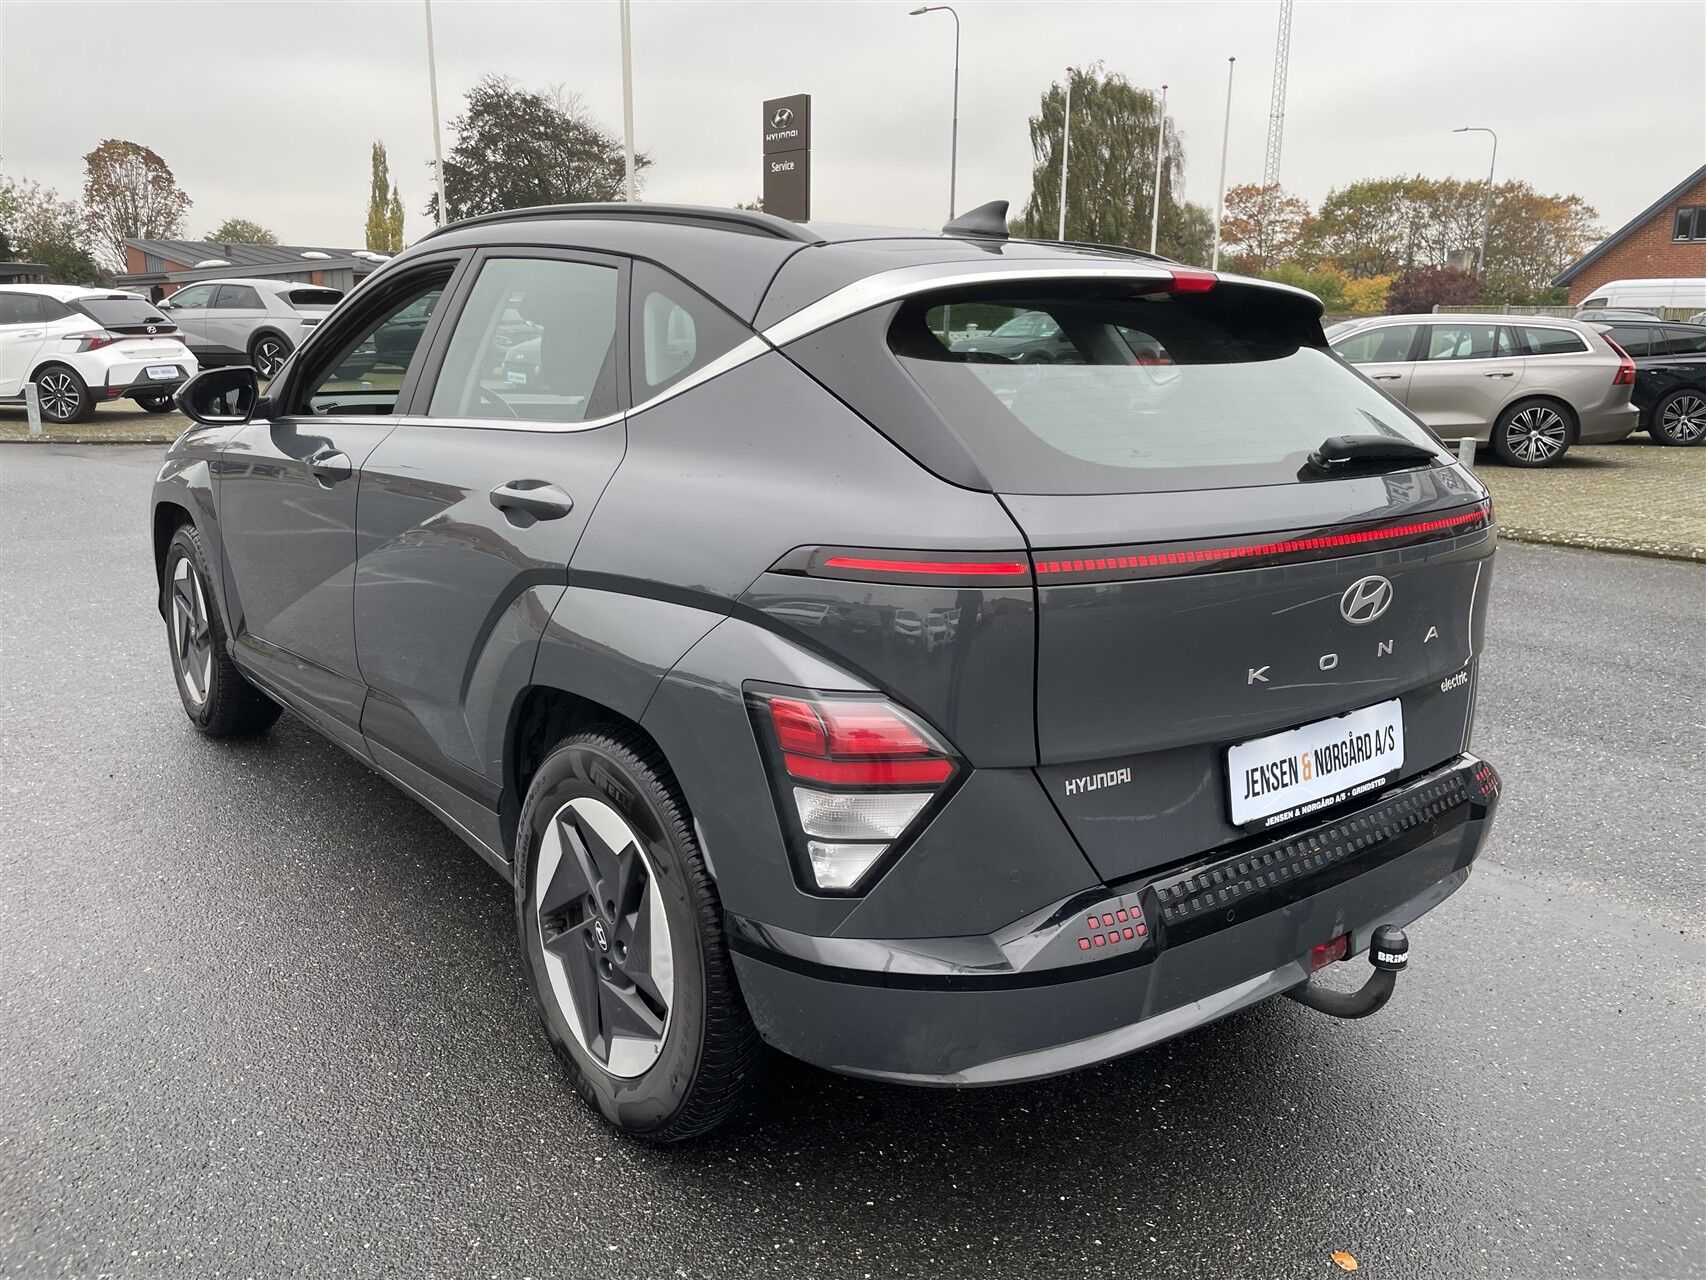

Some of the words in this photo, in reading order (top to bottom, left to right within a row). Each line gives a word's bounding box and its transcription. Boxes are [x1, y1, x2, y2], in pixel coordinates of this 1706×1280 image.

[766, 129, 799, 141] HYUNDAI
[771, 160, 795, 173] Service
[1247, 626, 1439, 685] KONA
[1440, 671, 1468, 693] electric
[1244, 755, 1299, 800] JENSEN
[1301, 752, 1312, 782] &
[1314, 731, 1372, 778] NØRGÅRD
[1375, 724, 1395, 760] A/S
[1065, 767, 1132, 796] HYUNDAI
[1265, 809, 1294, 827] JENSEN
[1335, 792, 1347, 803] A/S
[1351, 777, 1386, 796] GRINDSTED
